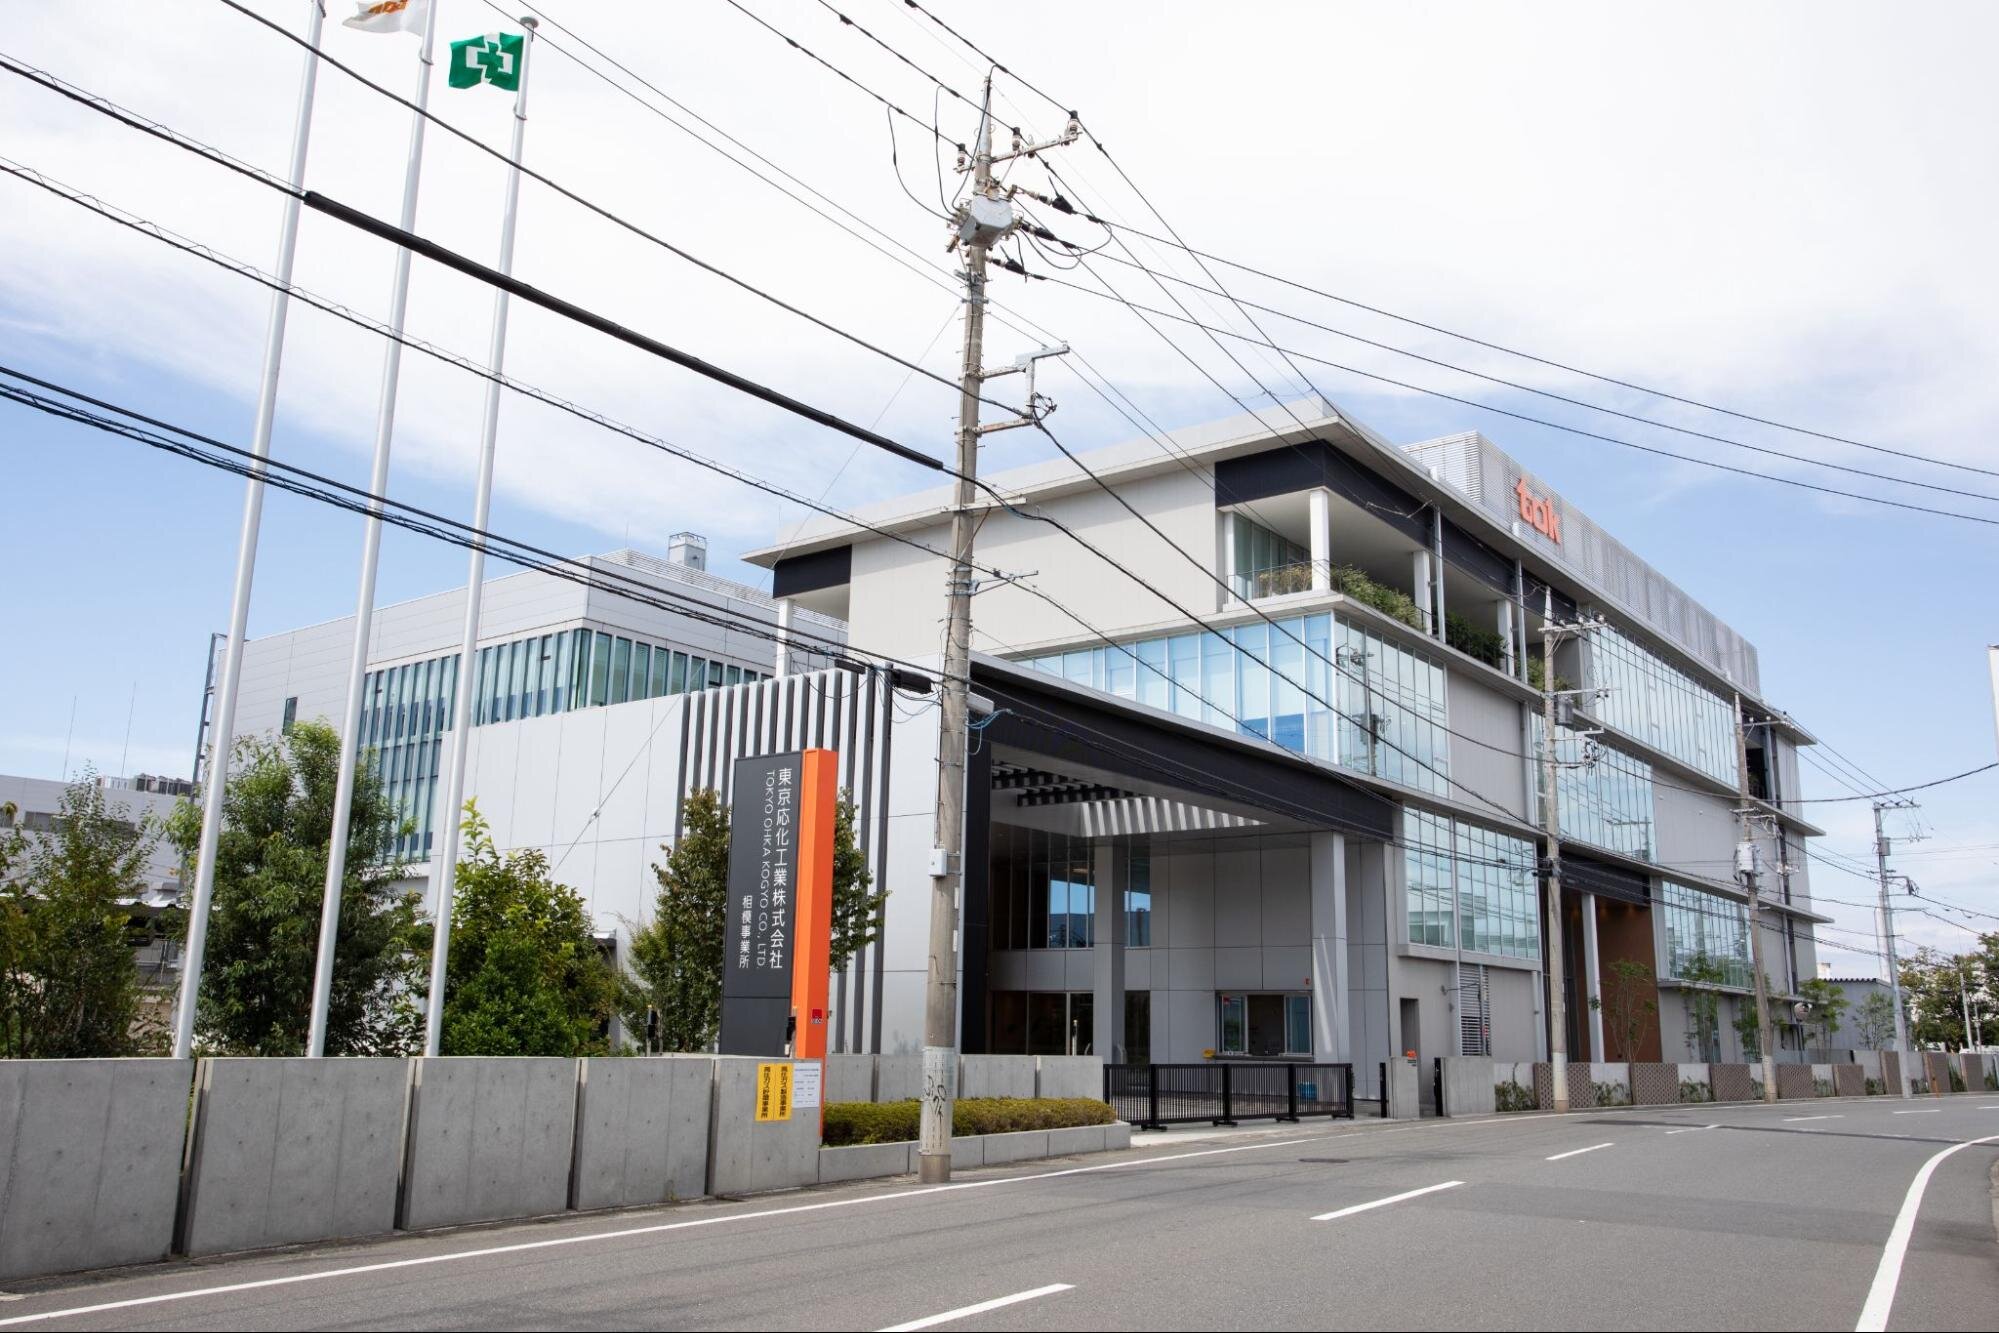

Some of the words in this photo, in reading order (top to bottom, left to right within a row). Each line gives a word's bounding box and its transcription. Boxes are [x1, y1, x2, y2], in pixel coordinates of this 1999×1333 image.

[1515, 478, 1562, 545] tok
[764, 770, 775, 814] TOKYO
[762, 818, 773, 857] OHKA
[760, 861, 770, 909] KOGYO
[769, 767, 793, 969] 東京応化工業株式会社
[739, 895, 753, 969] 相模事業所
[757, 912, 768, 938] CO.,
[756, 943, 767, 968] LTD.
